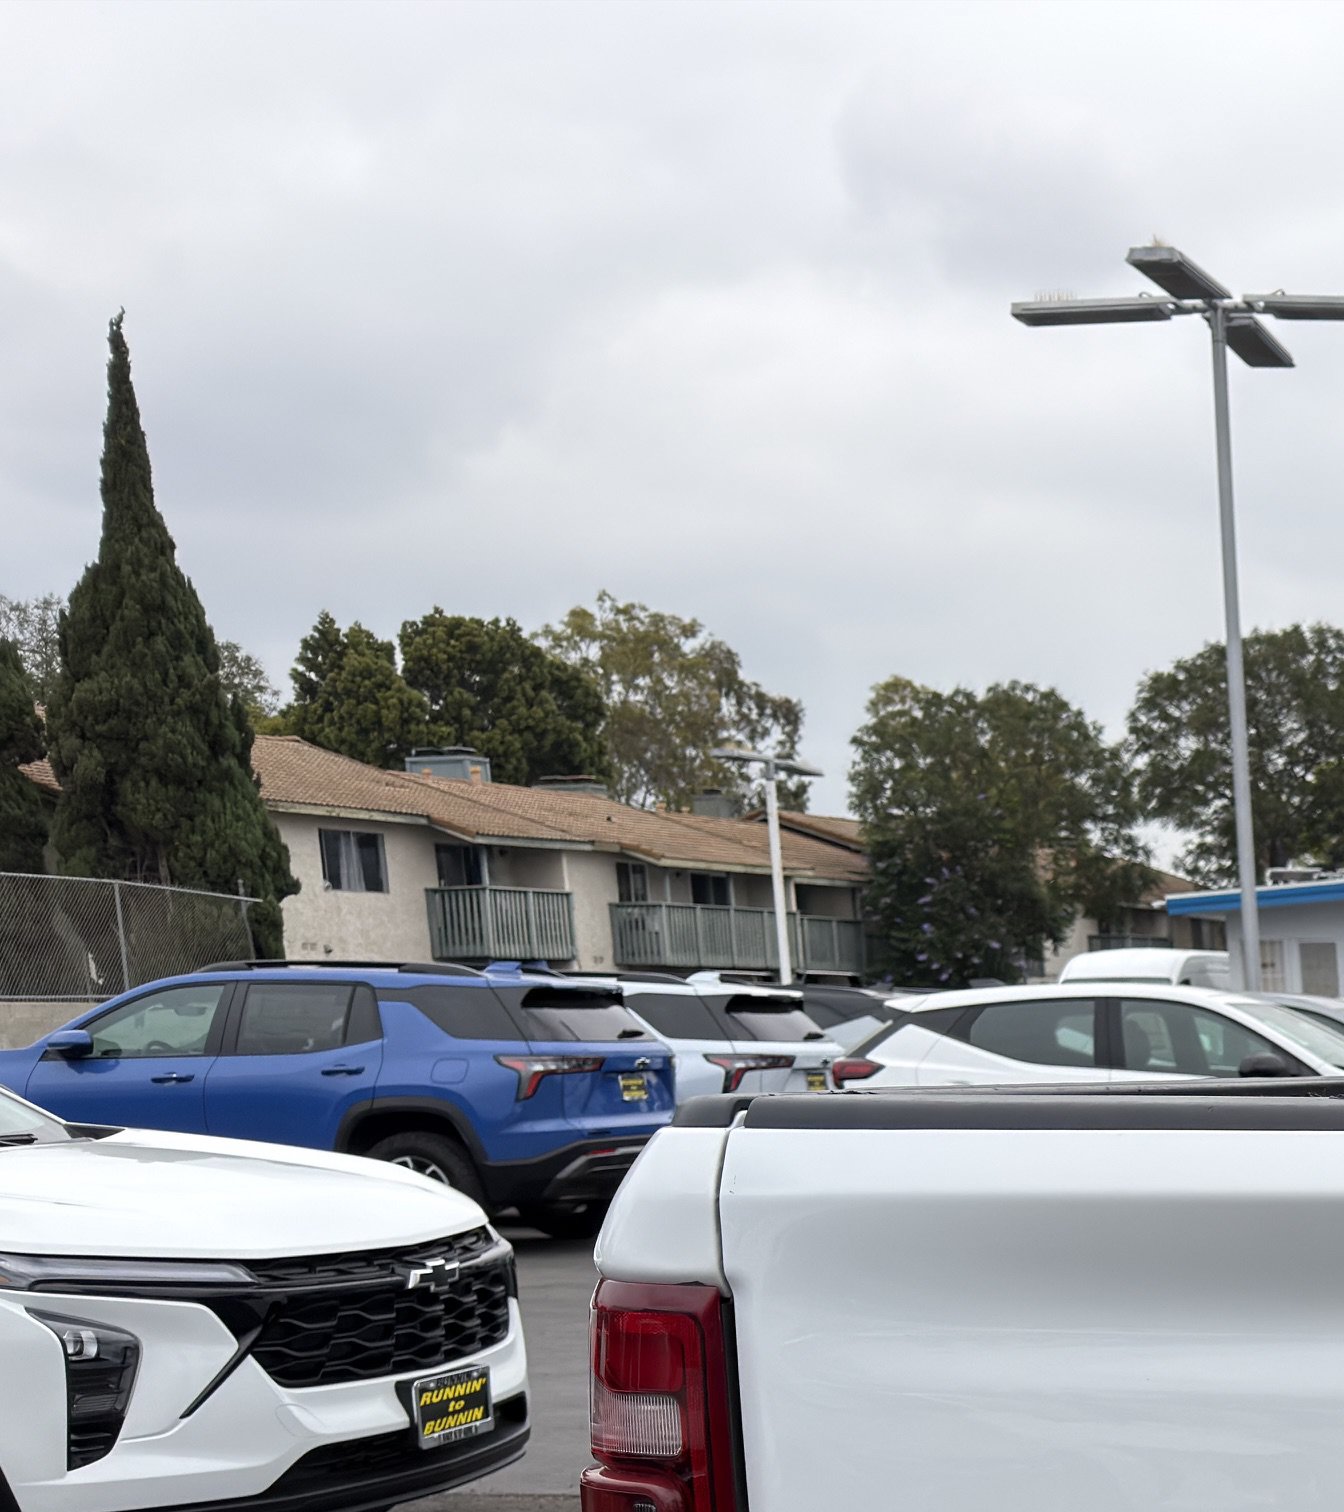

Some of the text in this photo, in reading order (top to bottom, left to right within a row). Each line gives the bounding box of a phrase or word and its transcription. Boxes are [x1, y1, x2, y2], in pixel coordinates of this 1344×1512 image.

[420, 1378, 487, 1407] RUNNIN'
[448, 1400, 465, 1413] to
[423, 1406, 484, 1435] BUNNIN
